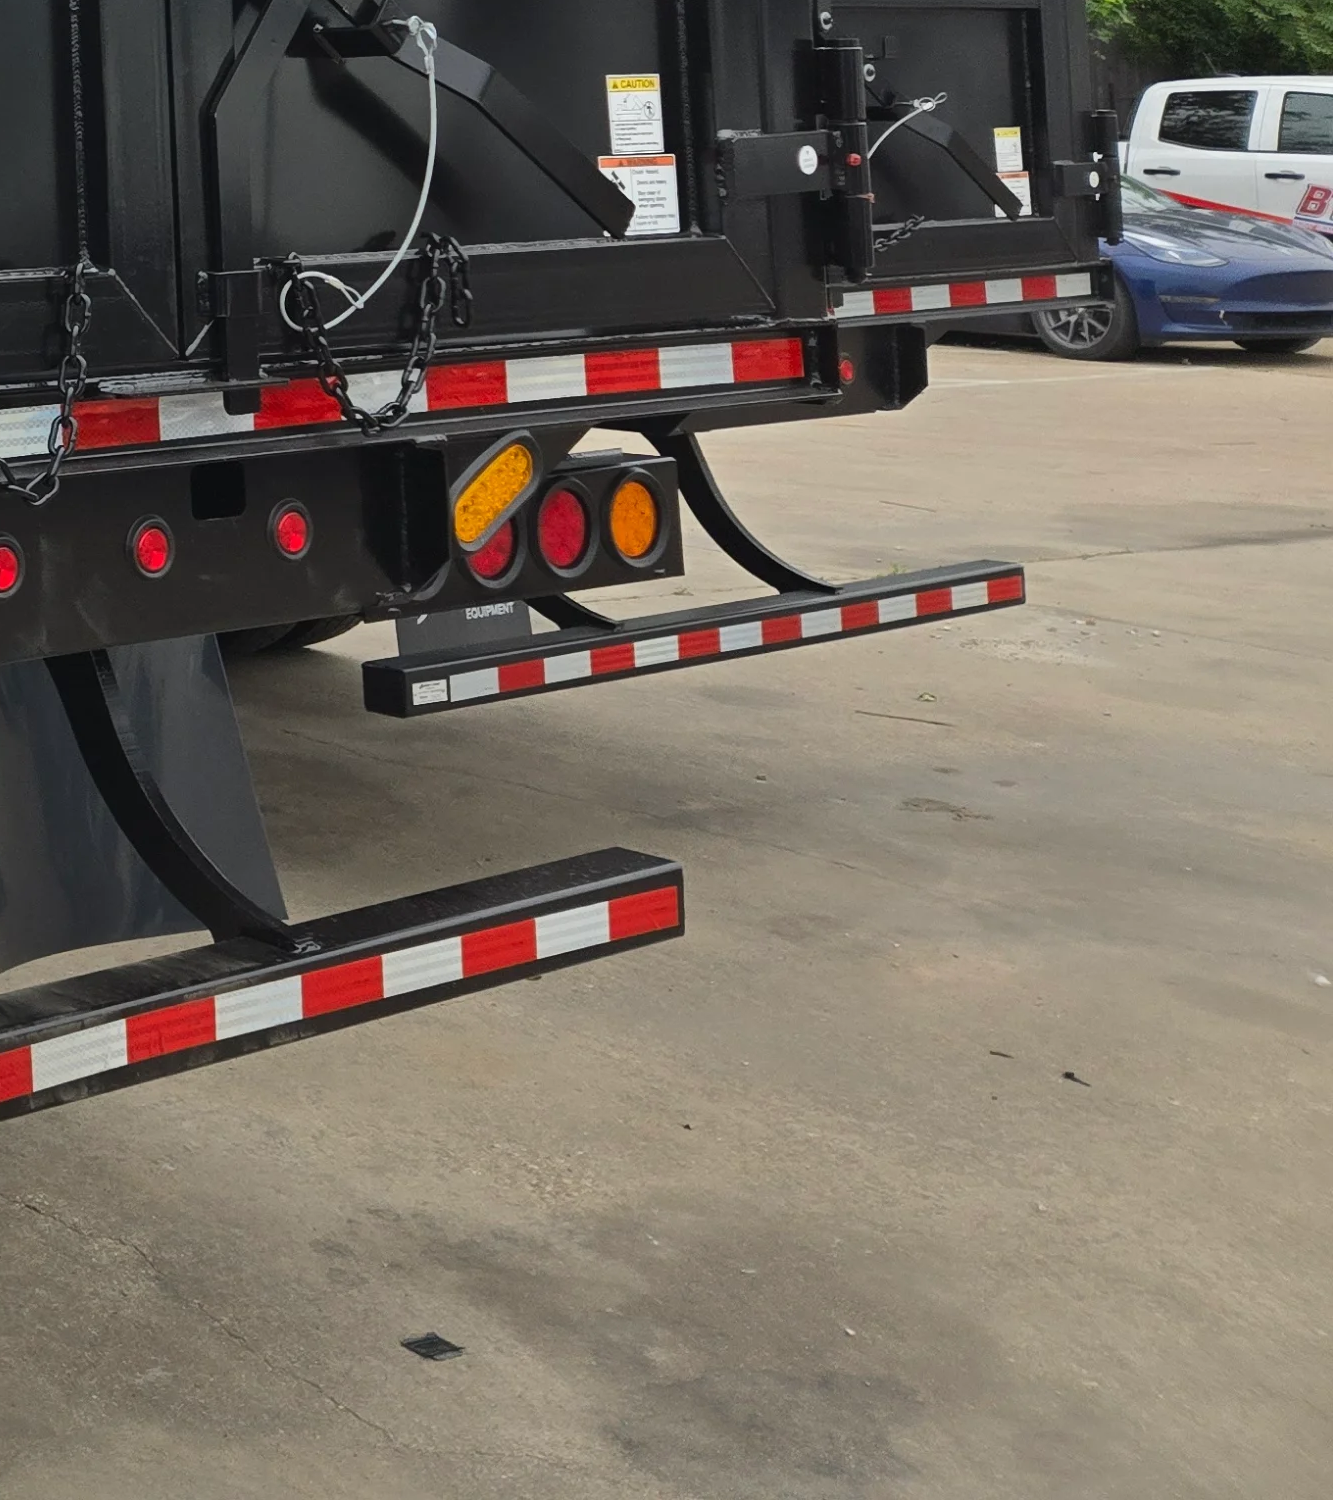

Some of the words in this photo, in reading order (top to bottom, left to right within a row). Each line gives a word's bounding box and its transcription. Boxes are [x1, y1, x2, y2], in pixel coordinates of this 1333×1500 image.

[621, 79, 655, 88] CAUTION
[1296, 184, 1333, 220] B
[465, 602, 515, 620] EQUIPMENT
